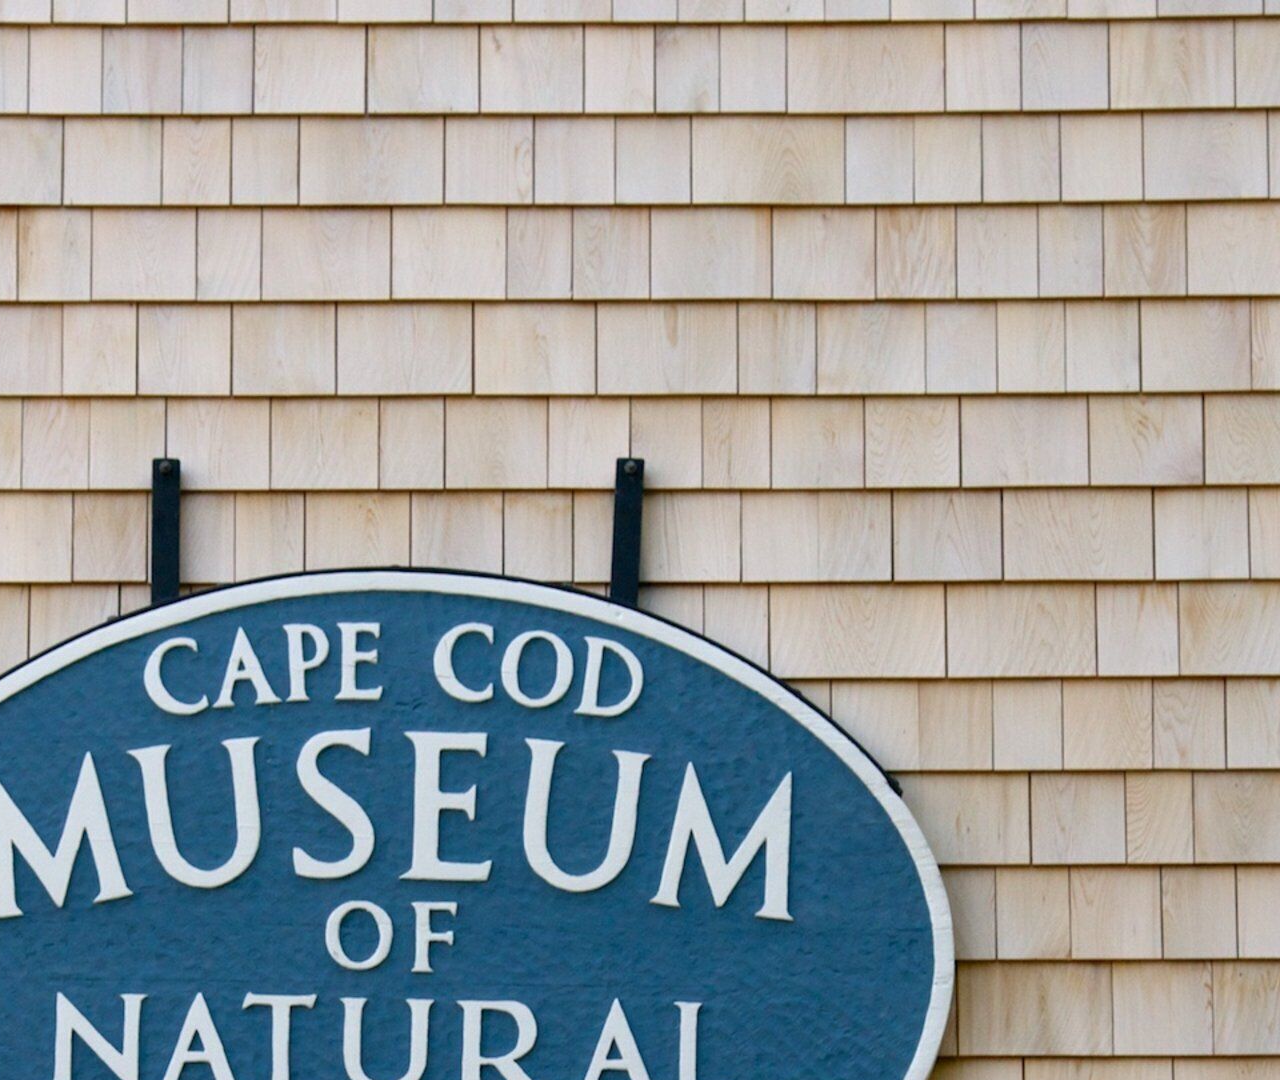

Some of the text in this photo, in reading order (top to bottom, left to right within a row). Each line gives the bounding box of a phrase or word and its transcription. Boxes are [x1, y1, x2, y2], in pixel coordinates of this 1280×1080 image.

[143, 622, 644, 718] CAPE COD
[324, 900, 457, 972] OF
